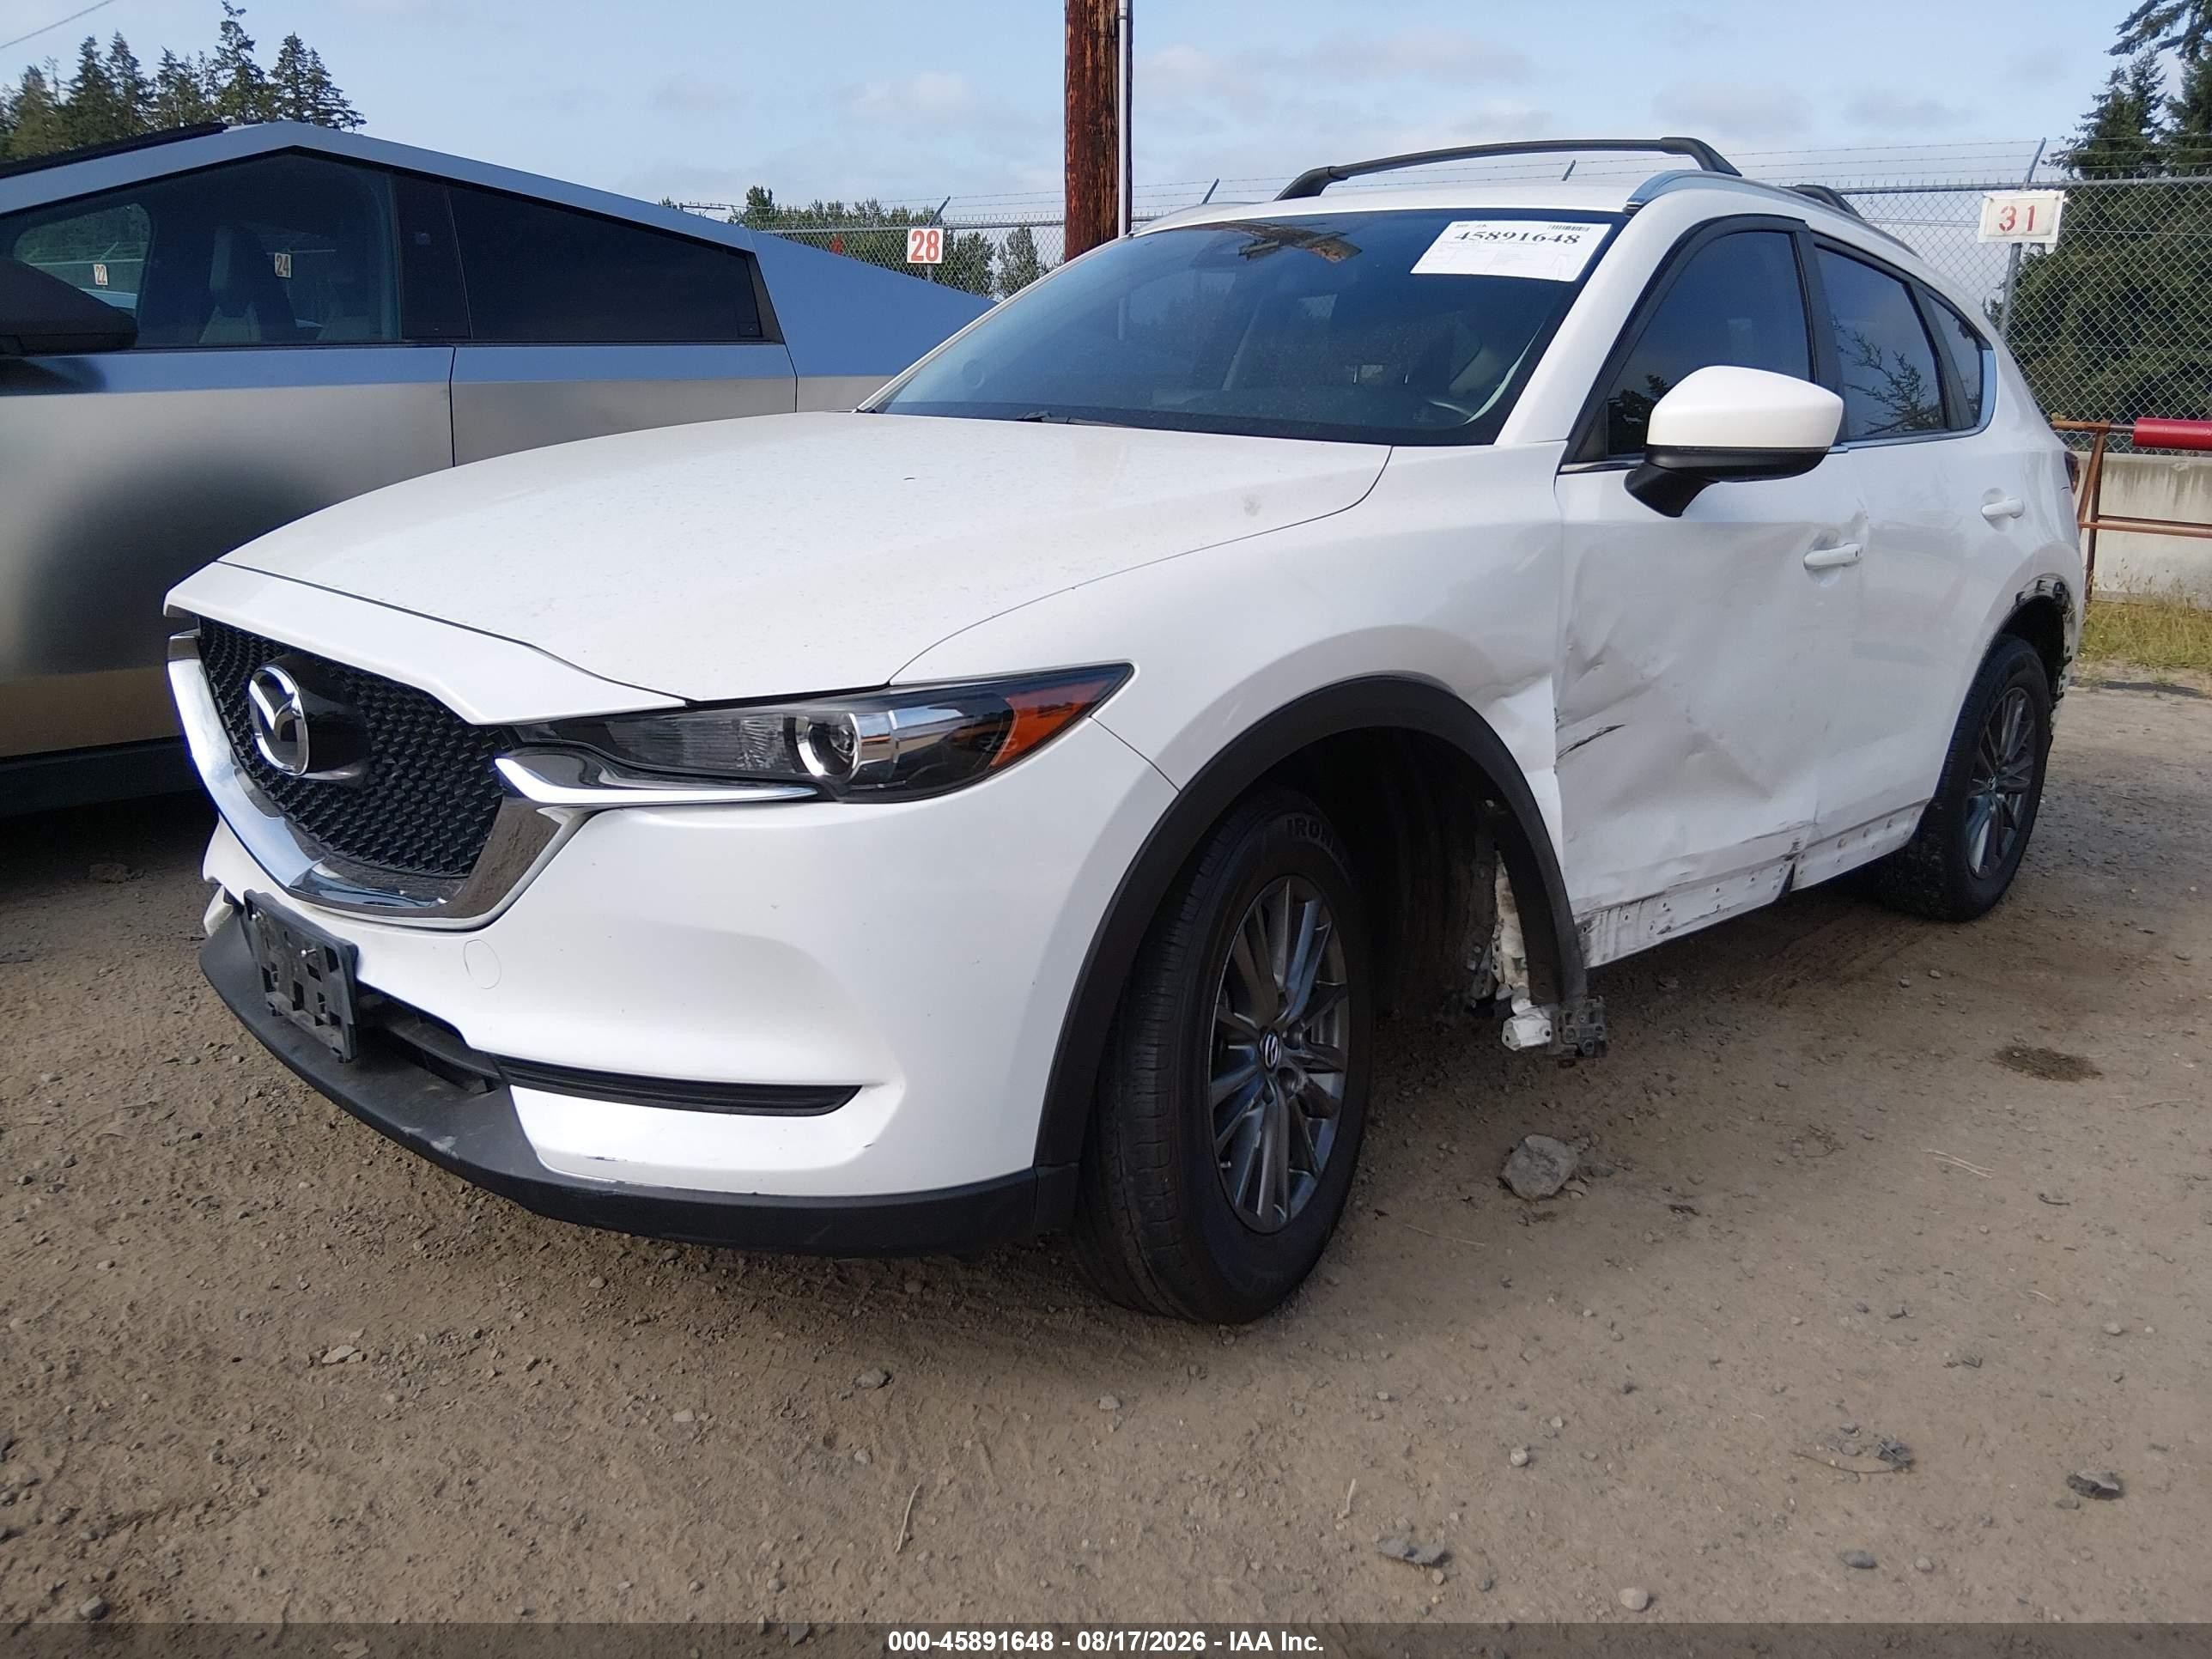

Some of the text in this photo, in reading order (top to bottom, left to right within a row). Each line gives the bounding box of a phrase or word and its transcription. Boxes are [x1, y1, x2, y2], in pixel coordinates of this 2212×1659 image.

[1999, 205, 2035, 232] 31
[911, 230, 939, 262] 28
[1454, 231, 1581, 245] 45891648
[276, 254, 289, 276] 24
